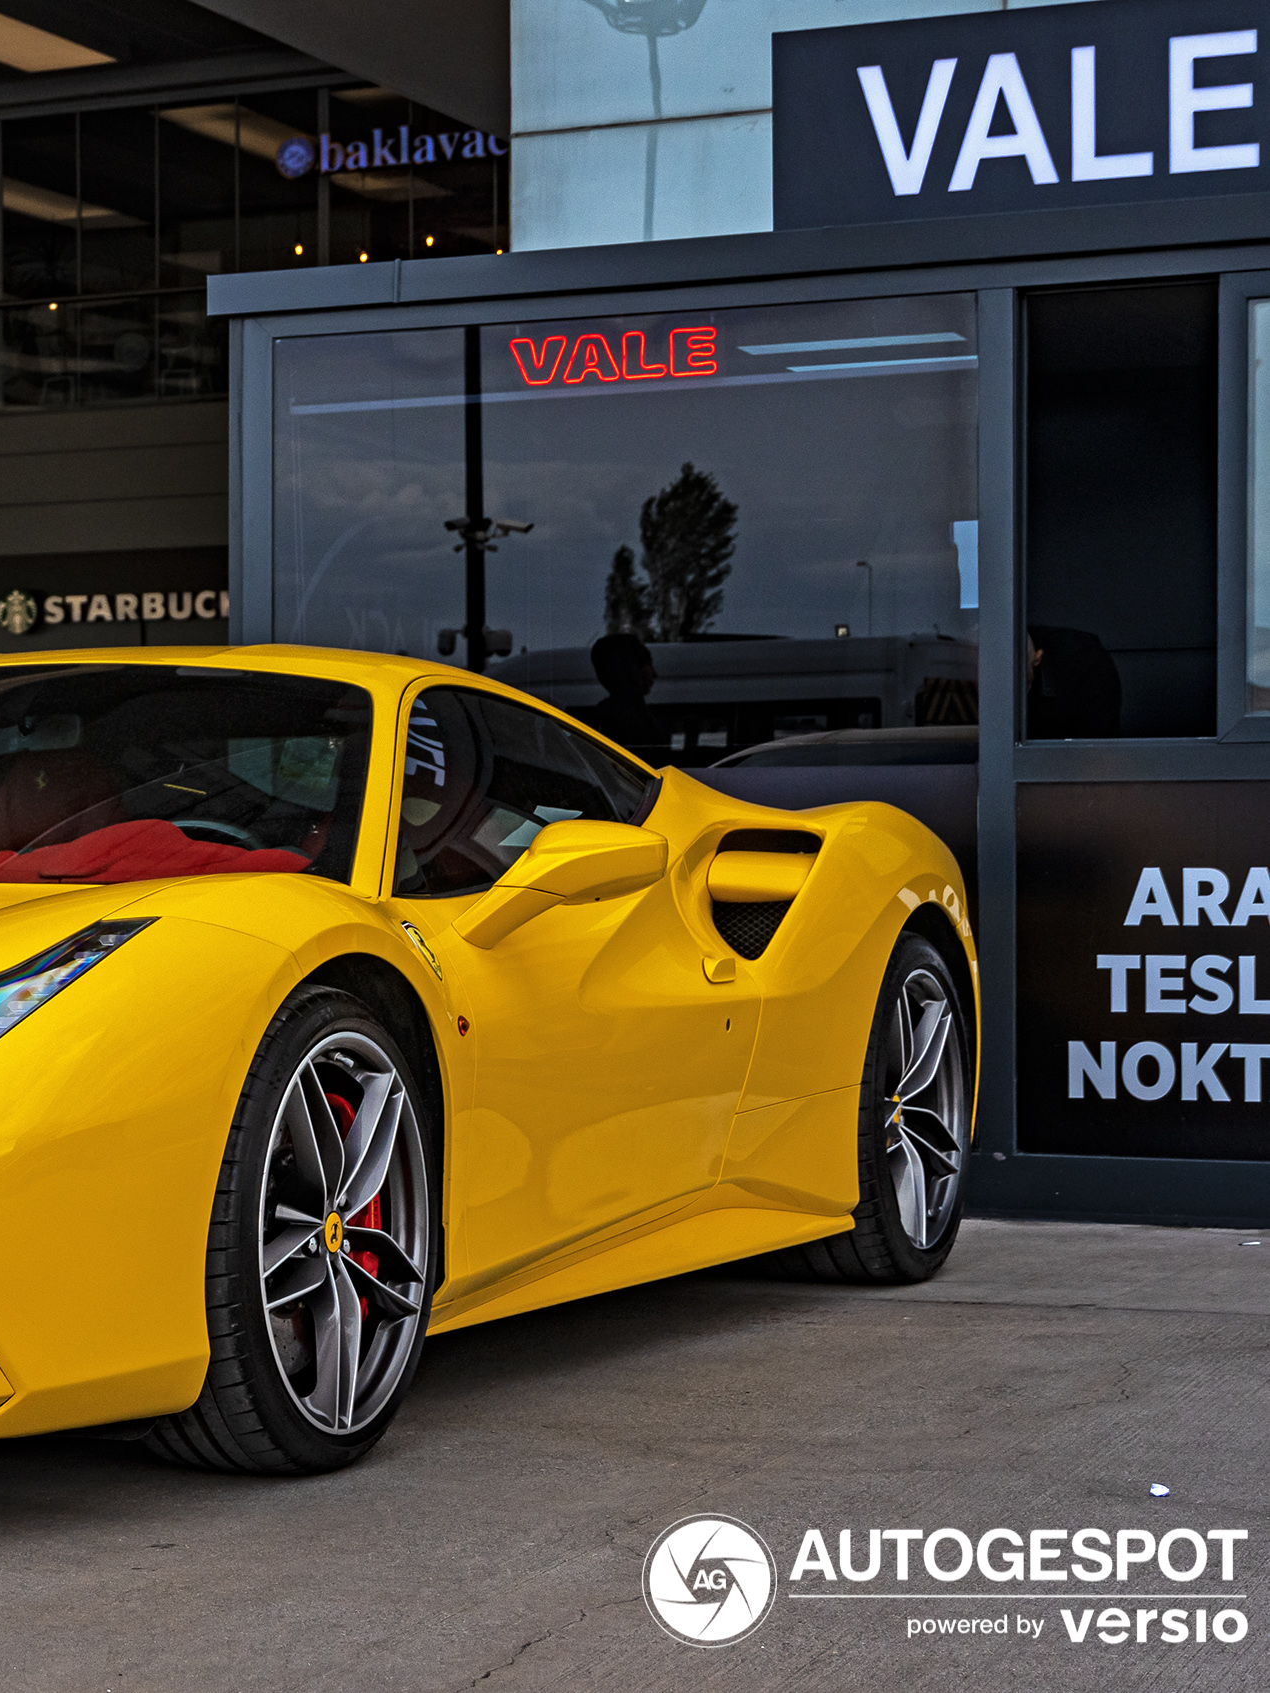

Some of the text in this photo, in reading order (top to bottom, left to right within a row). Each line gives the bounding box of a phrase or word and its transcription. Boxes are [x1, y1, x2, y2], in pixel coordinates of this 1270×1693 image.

[856, 28, 1260, 196] VALE
[509, 326, 718, 386] VALE
[1123, 866, 1270, 927] ARA
[1096, 953, 1270, 1016] TESL
[1068, 1040, 1270, 1103] NOKT
